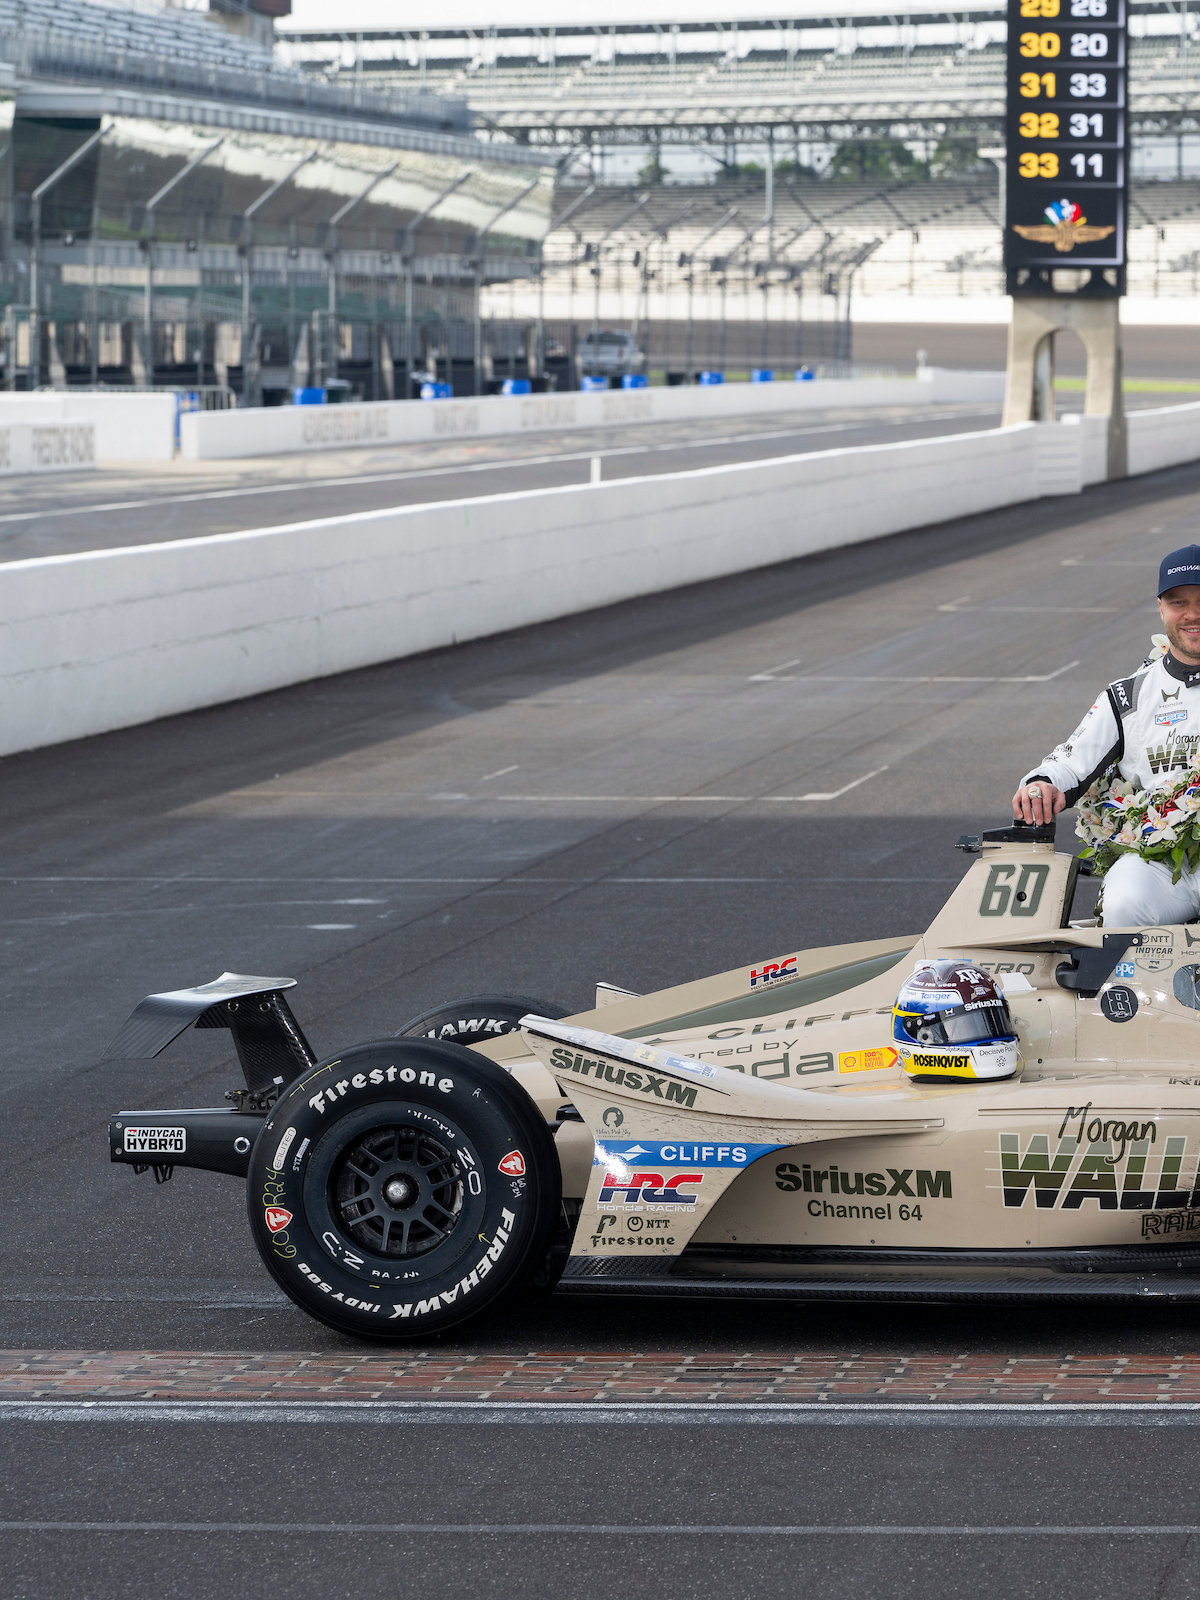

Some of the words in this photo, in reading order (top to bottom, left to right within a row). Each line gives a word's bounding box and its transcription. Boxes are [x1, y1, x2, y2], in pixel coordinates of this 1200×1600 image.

[1019, 32, 1060, 58] 30
[1070, 33, 1108, 57] 20
[1019, 72, 1056, 98] 31
[1069, 73, 1107, 97] 33
[1019, 112, 1060, 138] 32
[1069, 113, 1103, 137] 31
[1019, 152, 1059, 178] 33
[1070, 153, 1103, 177] 11
[1115, 683, 1130, 707] HRX
[1159, 701, 1183, 709] Honda
[1157, 713, 1186, 723] MSR
[1166, 728, 1200, 753] Morgan
[978, 864, 1051, 918] 60
[1135, 947, 1173, 955] INDYCAR
[1151, 935, 1170, 943] NTT
[750, 957, 797, 986] HRC
[1115, 962, 1135, 976] PPG
[921, 992, 951, 1000] Tanger
[708, 1004, 893, 1040] CLIFFS
[764, 1039, 799, 1050] by
[913, 1054, 970, 1068] ROSENQVIST
[308, 1064, 455, 1115] Firestone
[549, 1048, 698, 1108] SiriusXM
[1059, 1102, 1156, 1164] Morgan
[660, 1145, 747, 1163] CLIFFS
[597, 1172, 706, 1205] HRC
[774, 1163, 952, 1199] SiriusXM
[597, 1204, 643, 1212] Honda
[807, 1200, 892, 1220] Channel
[899, 1203, 923, 1221] 64
[647, 1220, 670, 1228] NTT
[272, 1230, 297, 1259] 60
[590, 1235, 675, 1248] Firestone
[388, 1206, 516, 1319] FIREHAWK
